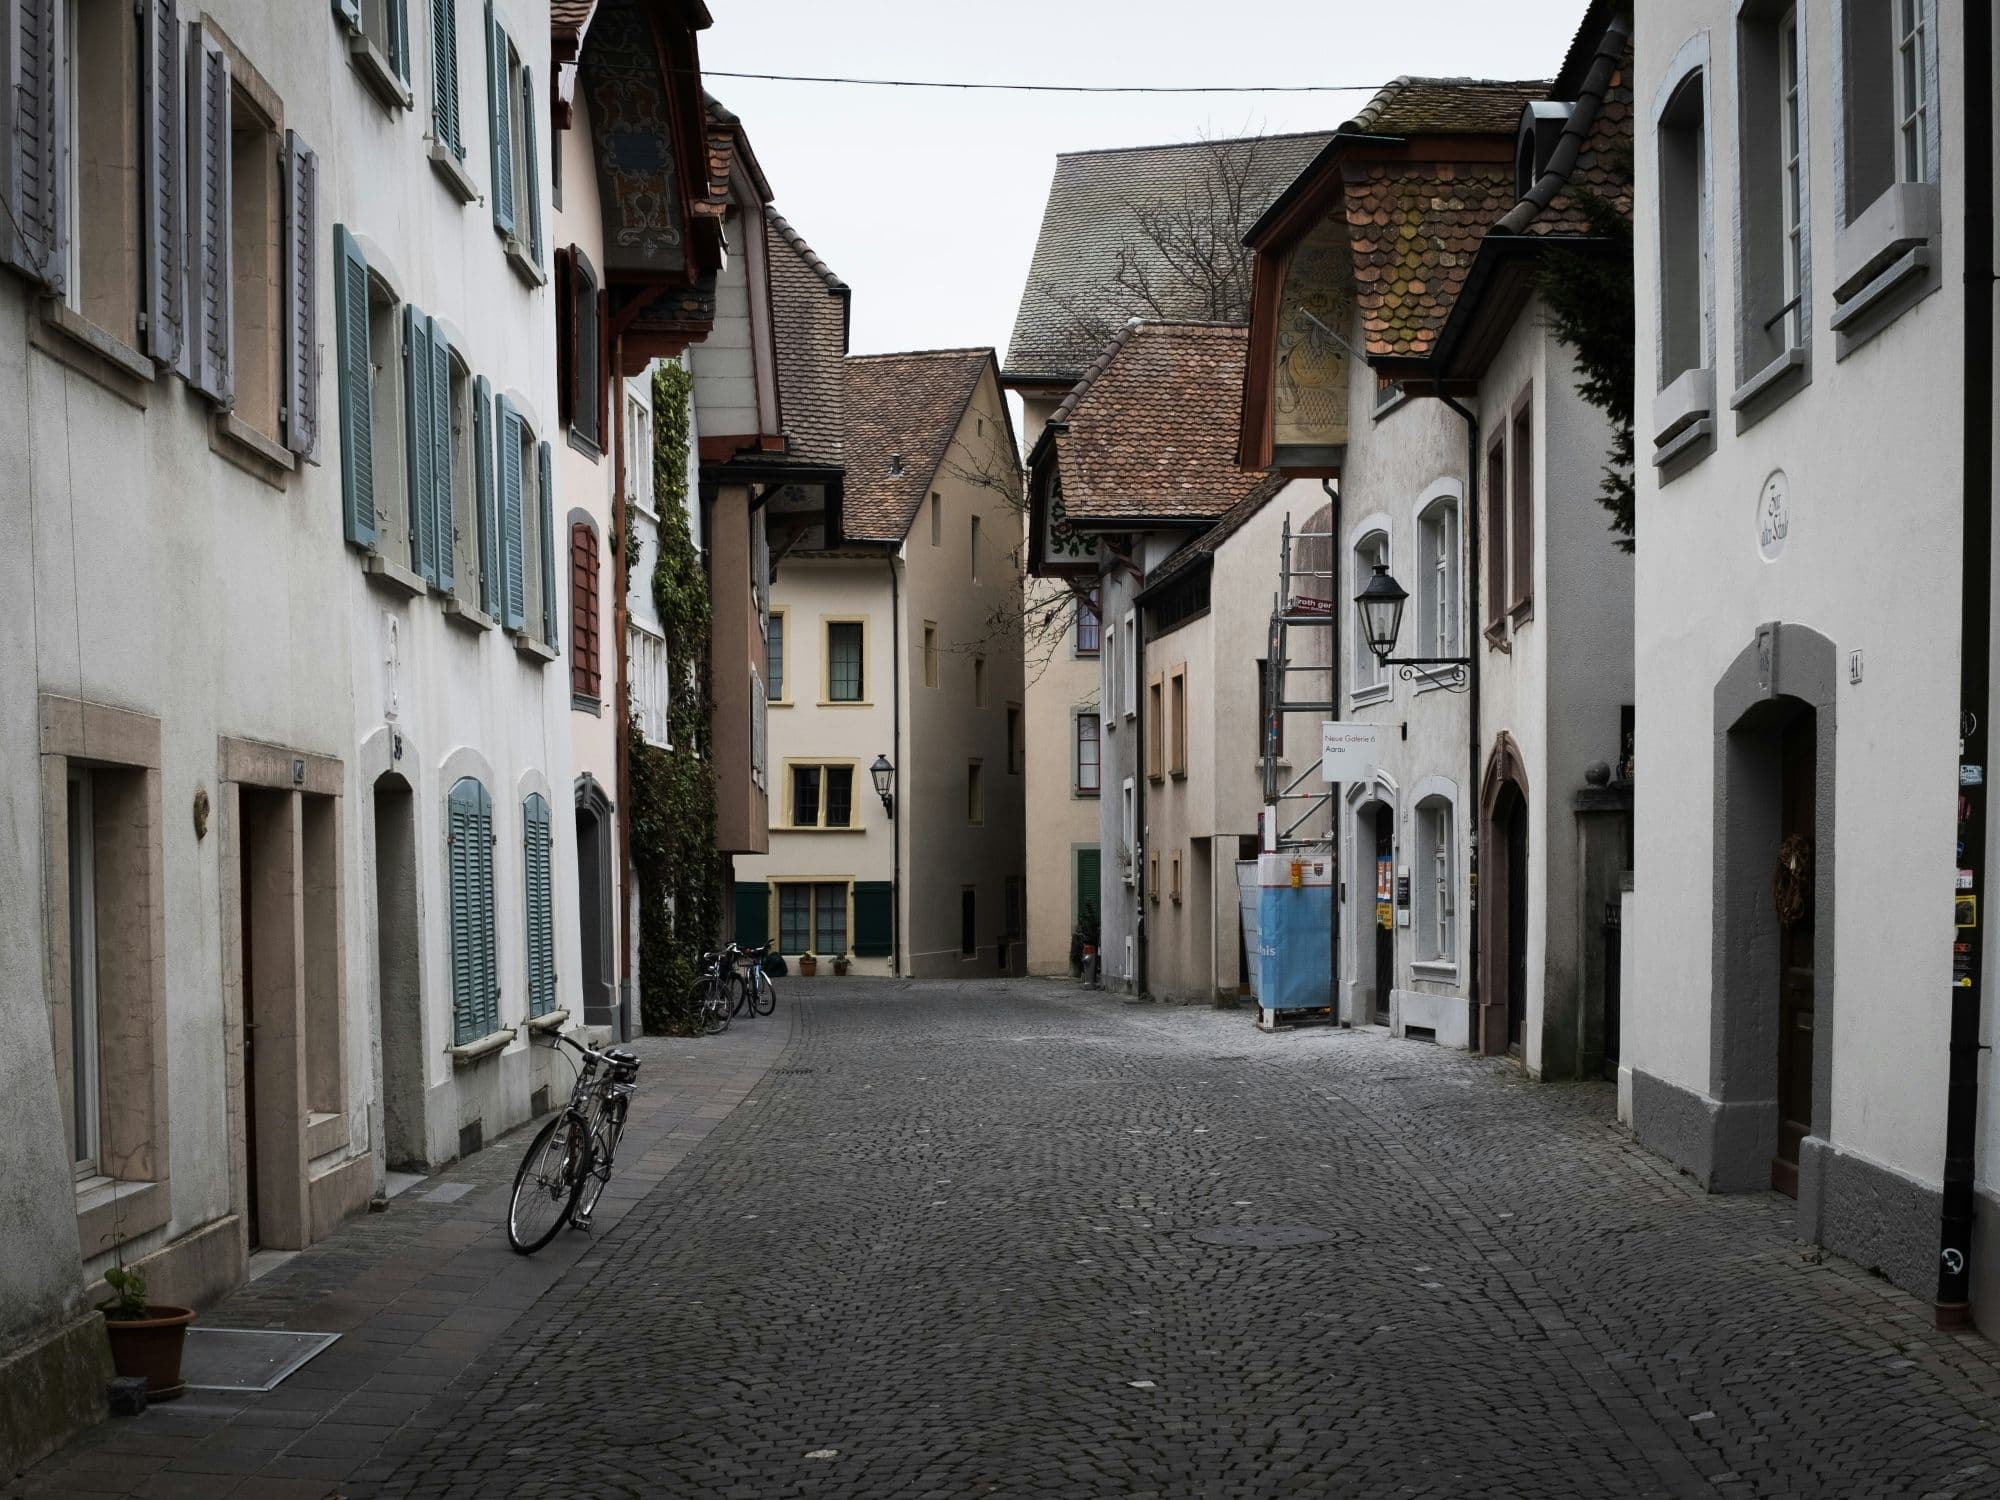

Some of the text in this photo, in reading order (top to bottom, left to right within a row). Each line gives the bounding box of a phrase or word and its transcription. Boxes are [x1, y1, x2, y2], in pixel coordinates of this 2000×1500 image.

[1298, 599, 1316, 607] roth
[1344, 734, 1369, 743] Galerie
[1325, 745, 1346, 753] Aarau
